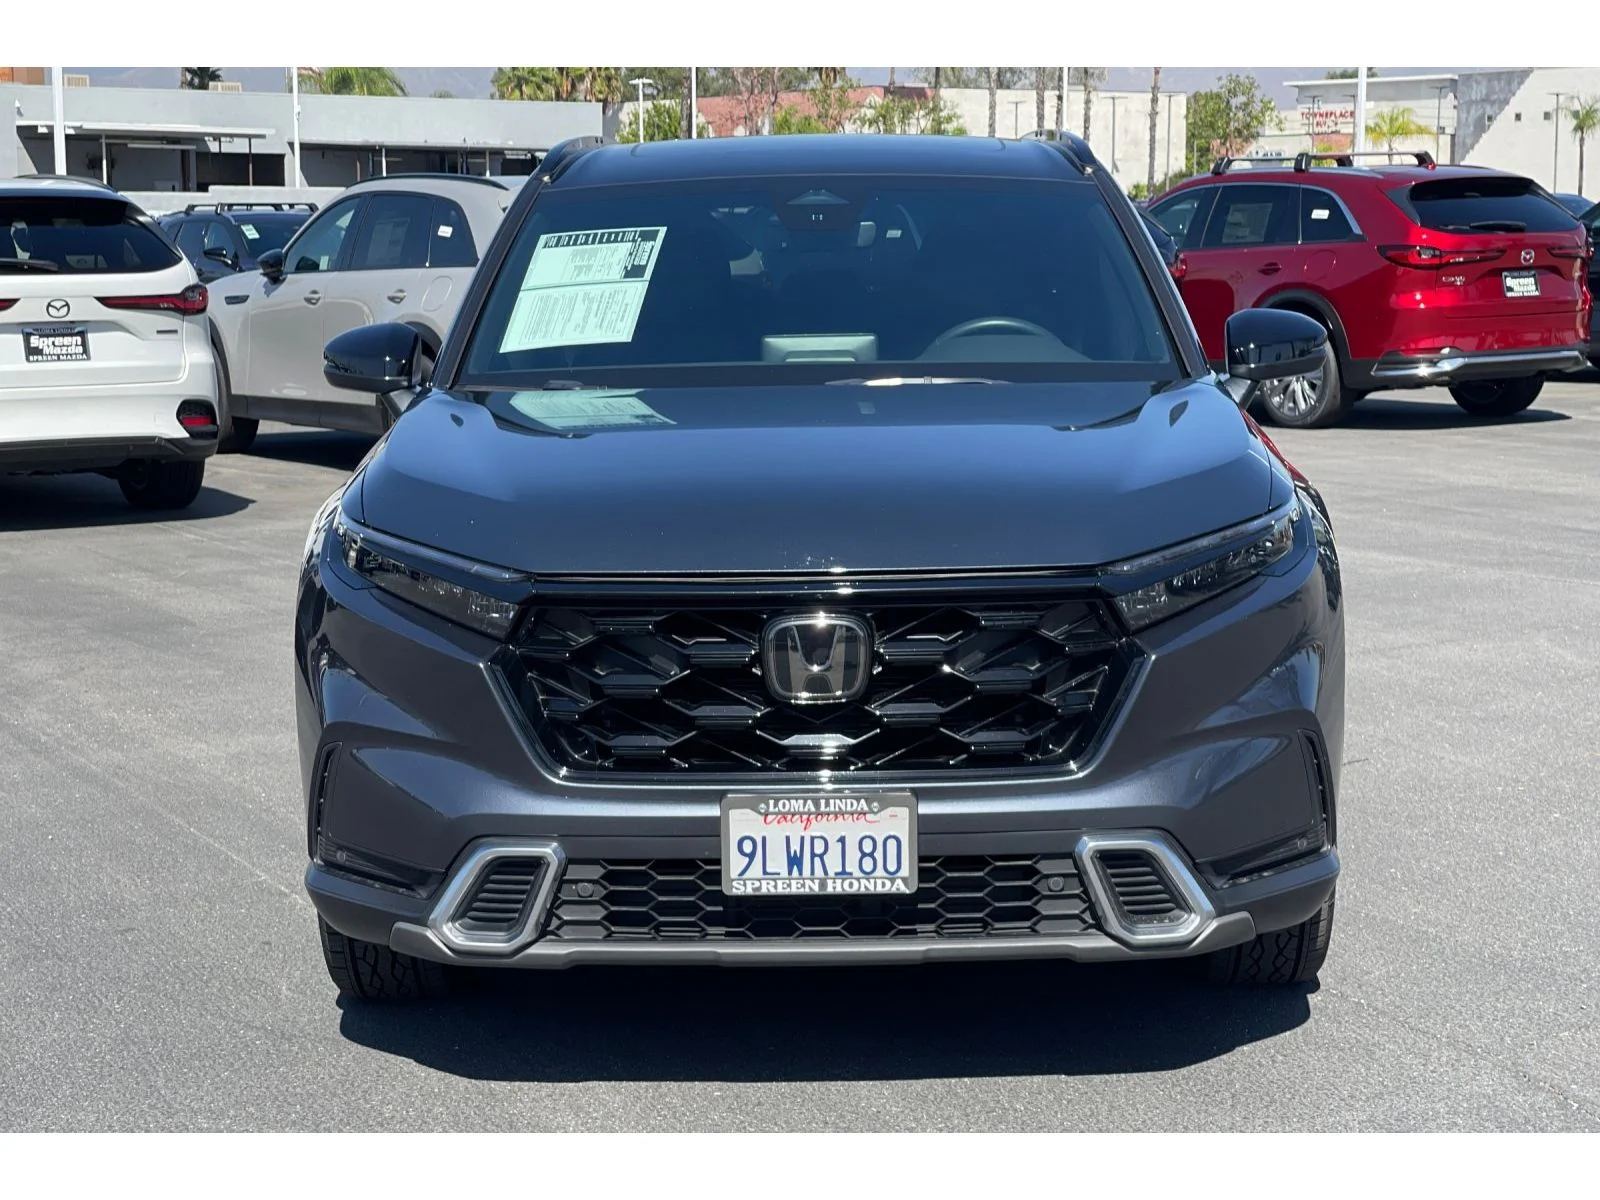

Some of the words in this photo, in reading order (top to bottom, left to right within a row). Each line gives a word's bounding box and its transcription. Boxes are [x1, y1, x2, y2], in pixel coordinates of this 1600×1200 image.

[30, 335, 82, 349] Spreen
[43, 345, 83, 355] Mazda
[768, 799, 816, 813] LOMA
[820, 798, 869, 812] LINDA
[736, 834, 903, 877] 9LWR180
[732, 879, 819, 894] SPREEN
[826, 878, 909, 894] HONDA
